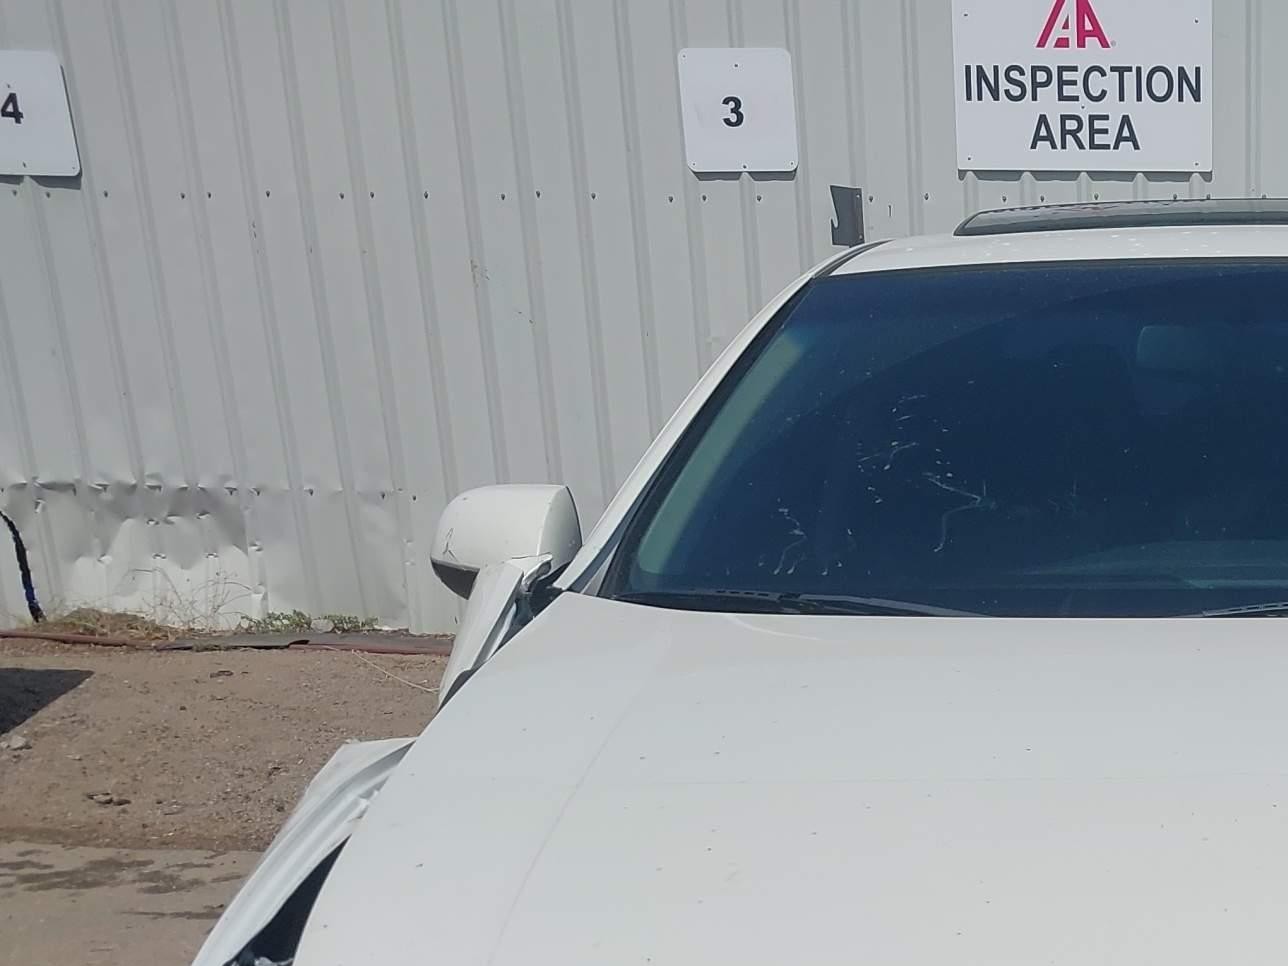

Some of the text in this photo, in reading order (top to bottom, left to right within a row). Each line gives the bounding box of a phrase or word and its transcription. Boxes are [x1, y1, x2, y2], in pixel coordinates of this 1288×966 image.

[964, 64, 1201, 103] INSPECTION
[0, 92, 24, 125] 4
[721, 96, 744, 128] 3
[1030, 113, 1141, 151] AREA
